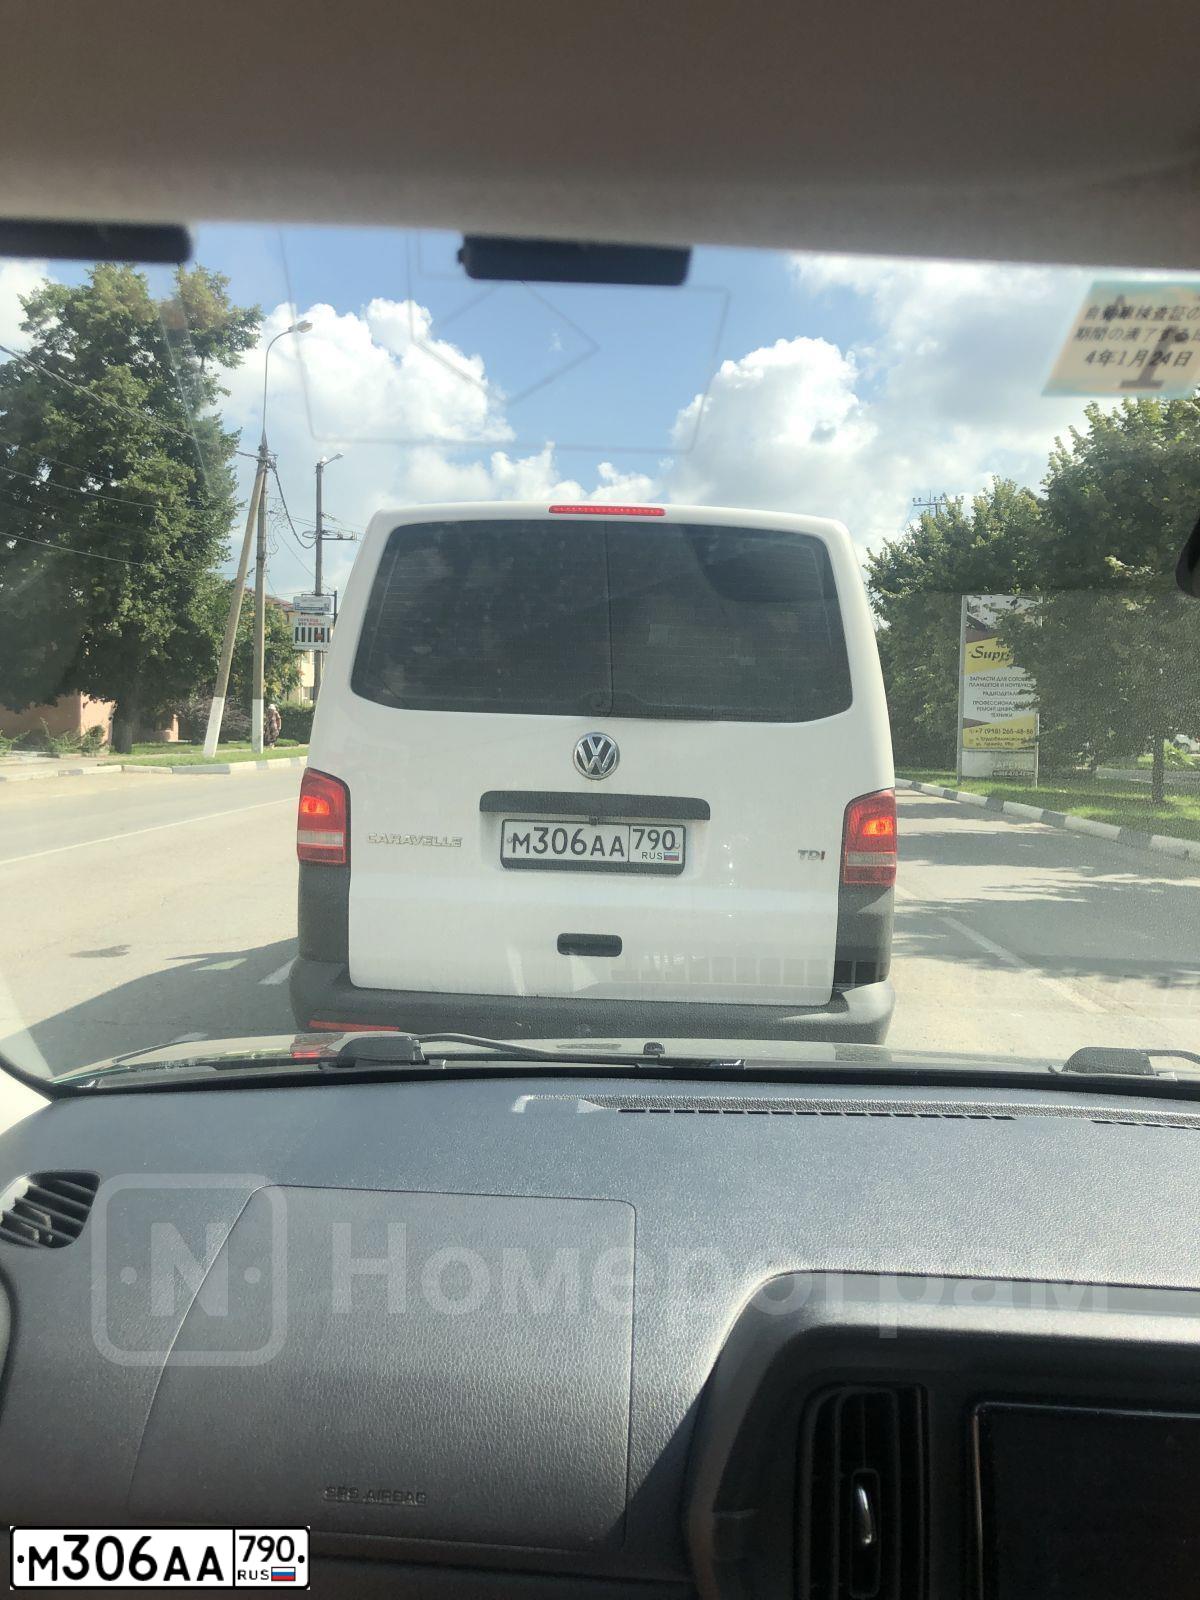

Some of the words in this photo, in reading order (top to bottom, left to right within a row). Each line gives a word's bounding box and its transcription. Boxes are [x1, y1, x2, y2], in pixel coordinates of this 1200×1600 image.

[367, 832, 463, 848] CARAVELLE
[511, 826, 625, 858] М306АА
[632, 828, 676, 851] 790
[641, 851, 663, 860] RUS
[797, 849, 826, 861] TDI
[322, 1486, 360, 1503] SRS
